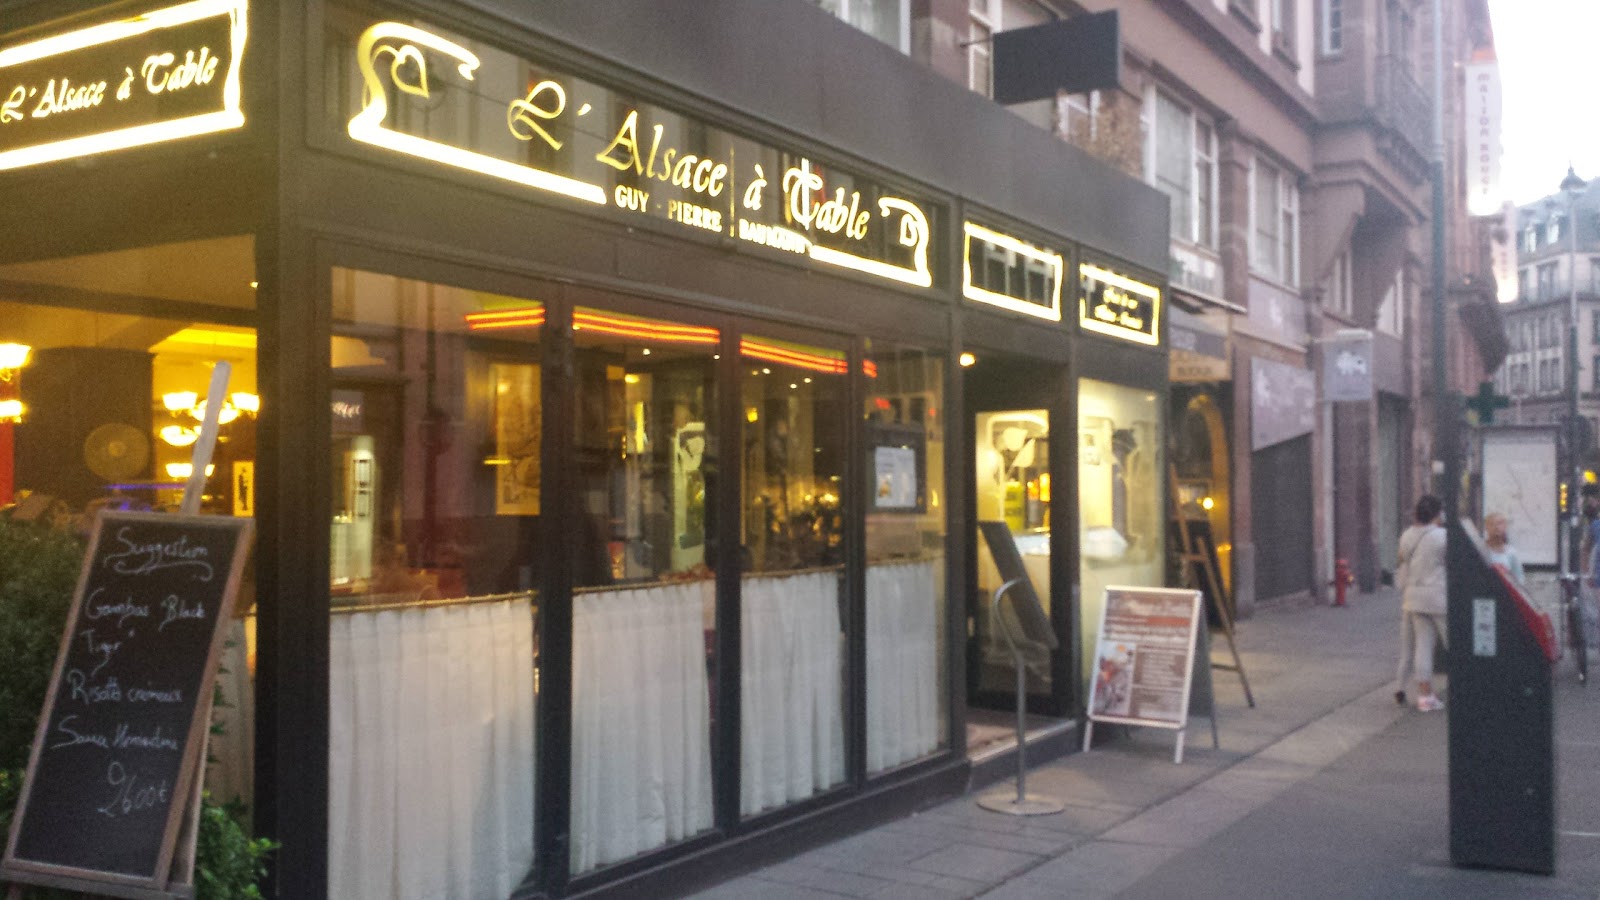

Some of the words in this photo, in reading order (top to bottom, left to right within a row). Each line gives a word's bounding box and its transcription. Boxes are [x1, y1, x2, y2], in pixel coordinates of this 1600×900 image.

[0, 78, 107, 123] L'Alsace
[116, 66, 134, 101] à
[141, 46, 219, 94] Table
[614, 184, 649, 212] GUY
[667, 199, 722, 233] PIERRE
[743, 164, 768, 211] à
[782, 158, 872, 240] Table
